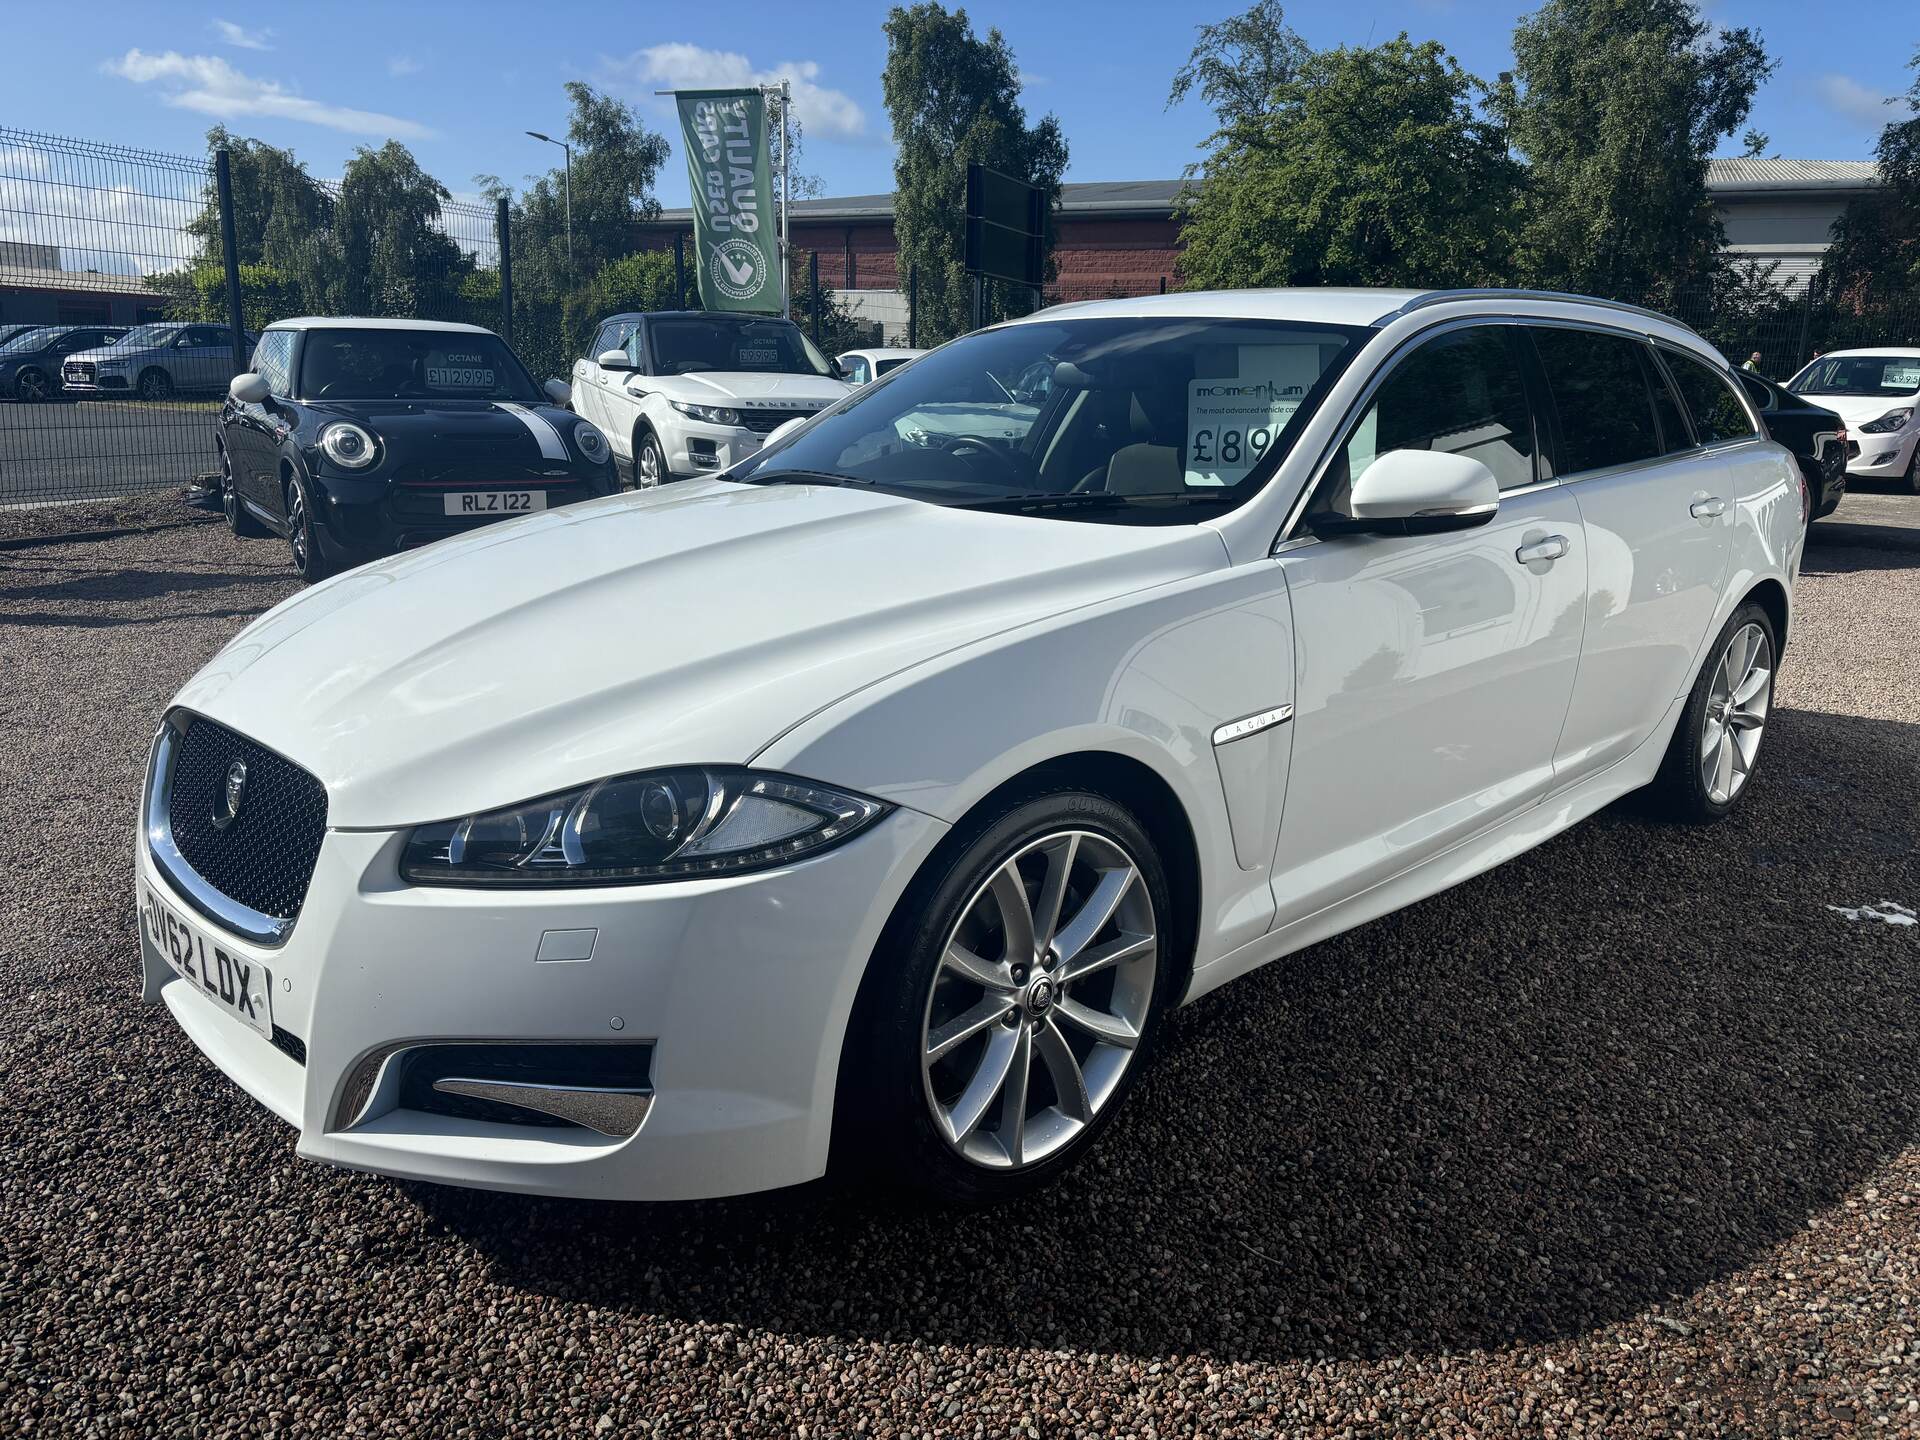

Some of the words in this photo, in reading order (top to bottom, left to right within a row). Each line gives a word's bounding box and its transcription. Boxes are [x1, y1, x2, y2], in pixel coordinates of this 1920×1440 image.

[448, 354, 482, 362] OCTANE
[428, 369, 494, 384] £12995
[1226, 407, 1259, 416] advanced
[462, 494, 498, 511] RLZ
[503, 493, 531, 510] 122
[198, 936, 256, 1020] LDX
